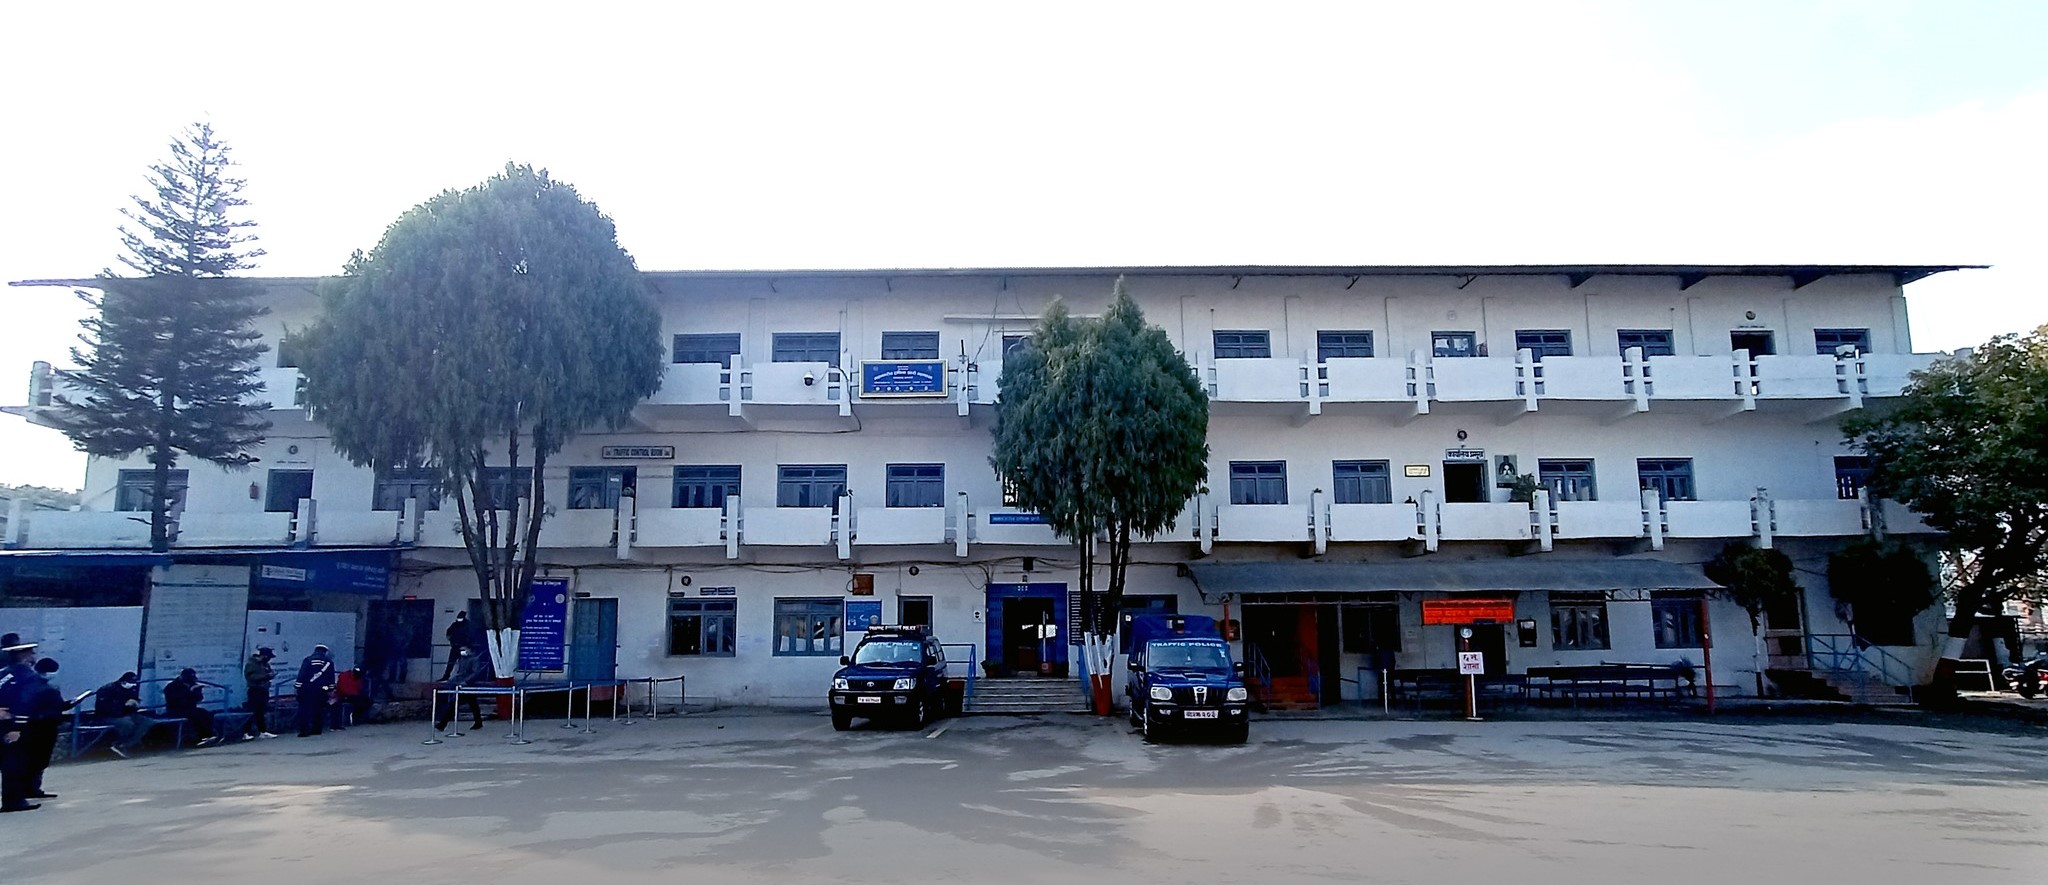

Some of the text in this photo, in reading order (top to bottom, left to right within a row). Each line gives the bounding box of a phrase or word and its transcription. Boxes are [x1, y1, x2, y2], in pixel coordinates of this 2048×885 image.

[613, 448, 663, 456] TRAFFIC CONTROL ROOM
